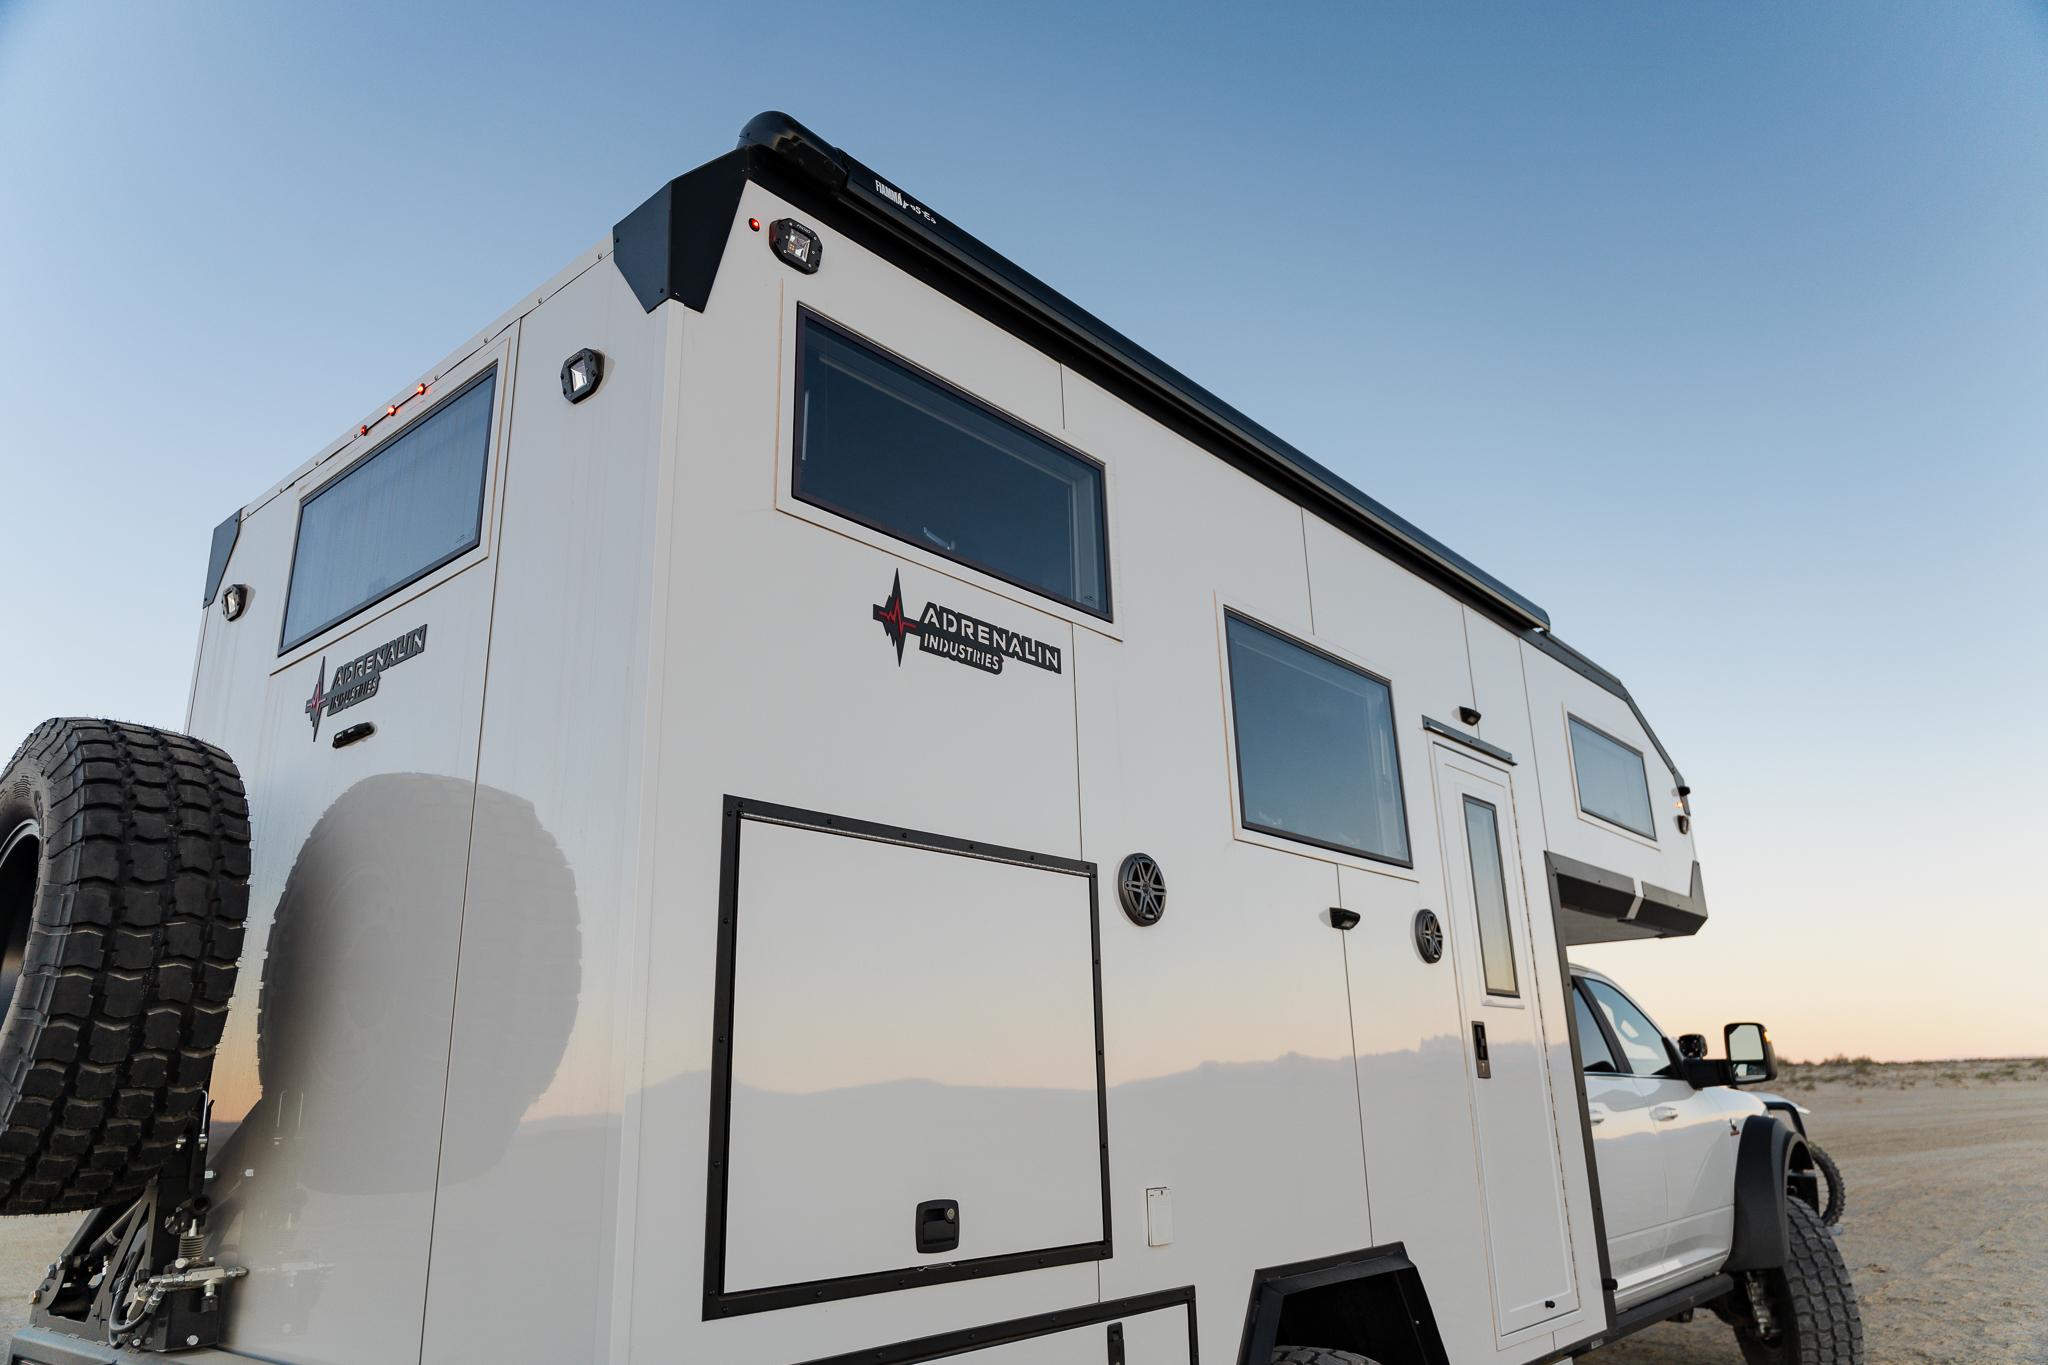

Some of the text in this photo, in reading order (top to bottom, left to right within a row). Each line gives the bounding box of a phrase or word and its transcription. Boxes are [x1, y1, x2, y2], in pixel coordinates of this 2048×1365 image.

[334, 627, 424, 689] ADRENALIN
[922, 606, 1059, 669] ADRENALIN
[923, 633, 1000, 670] INDUSTRIES
